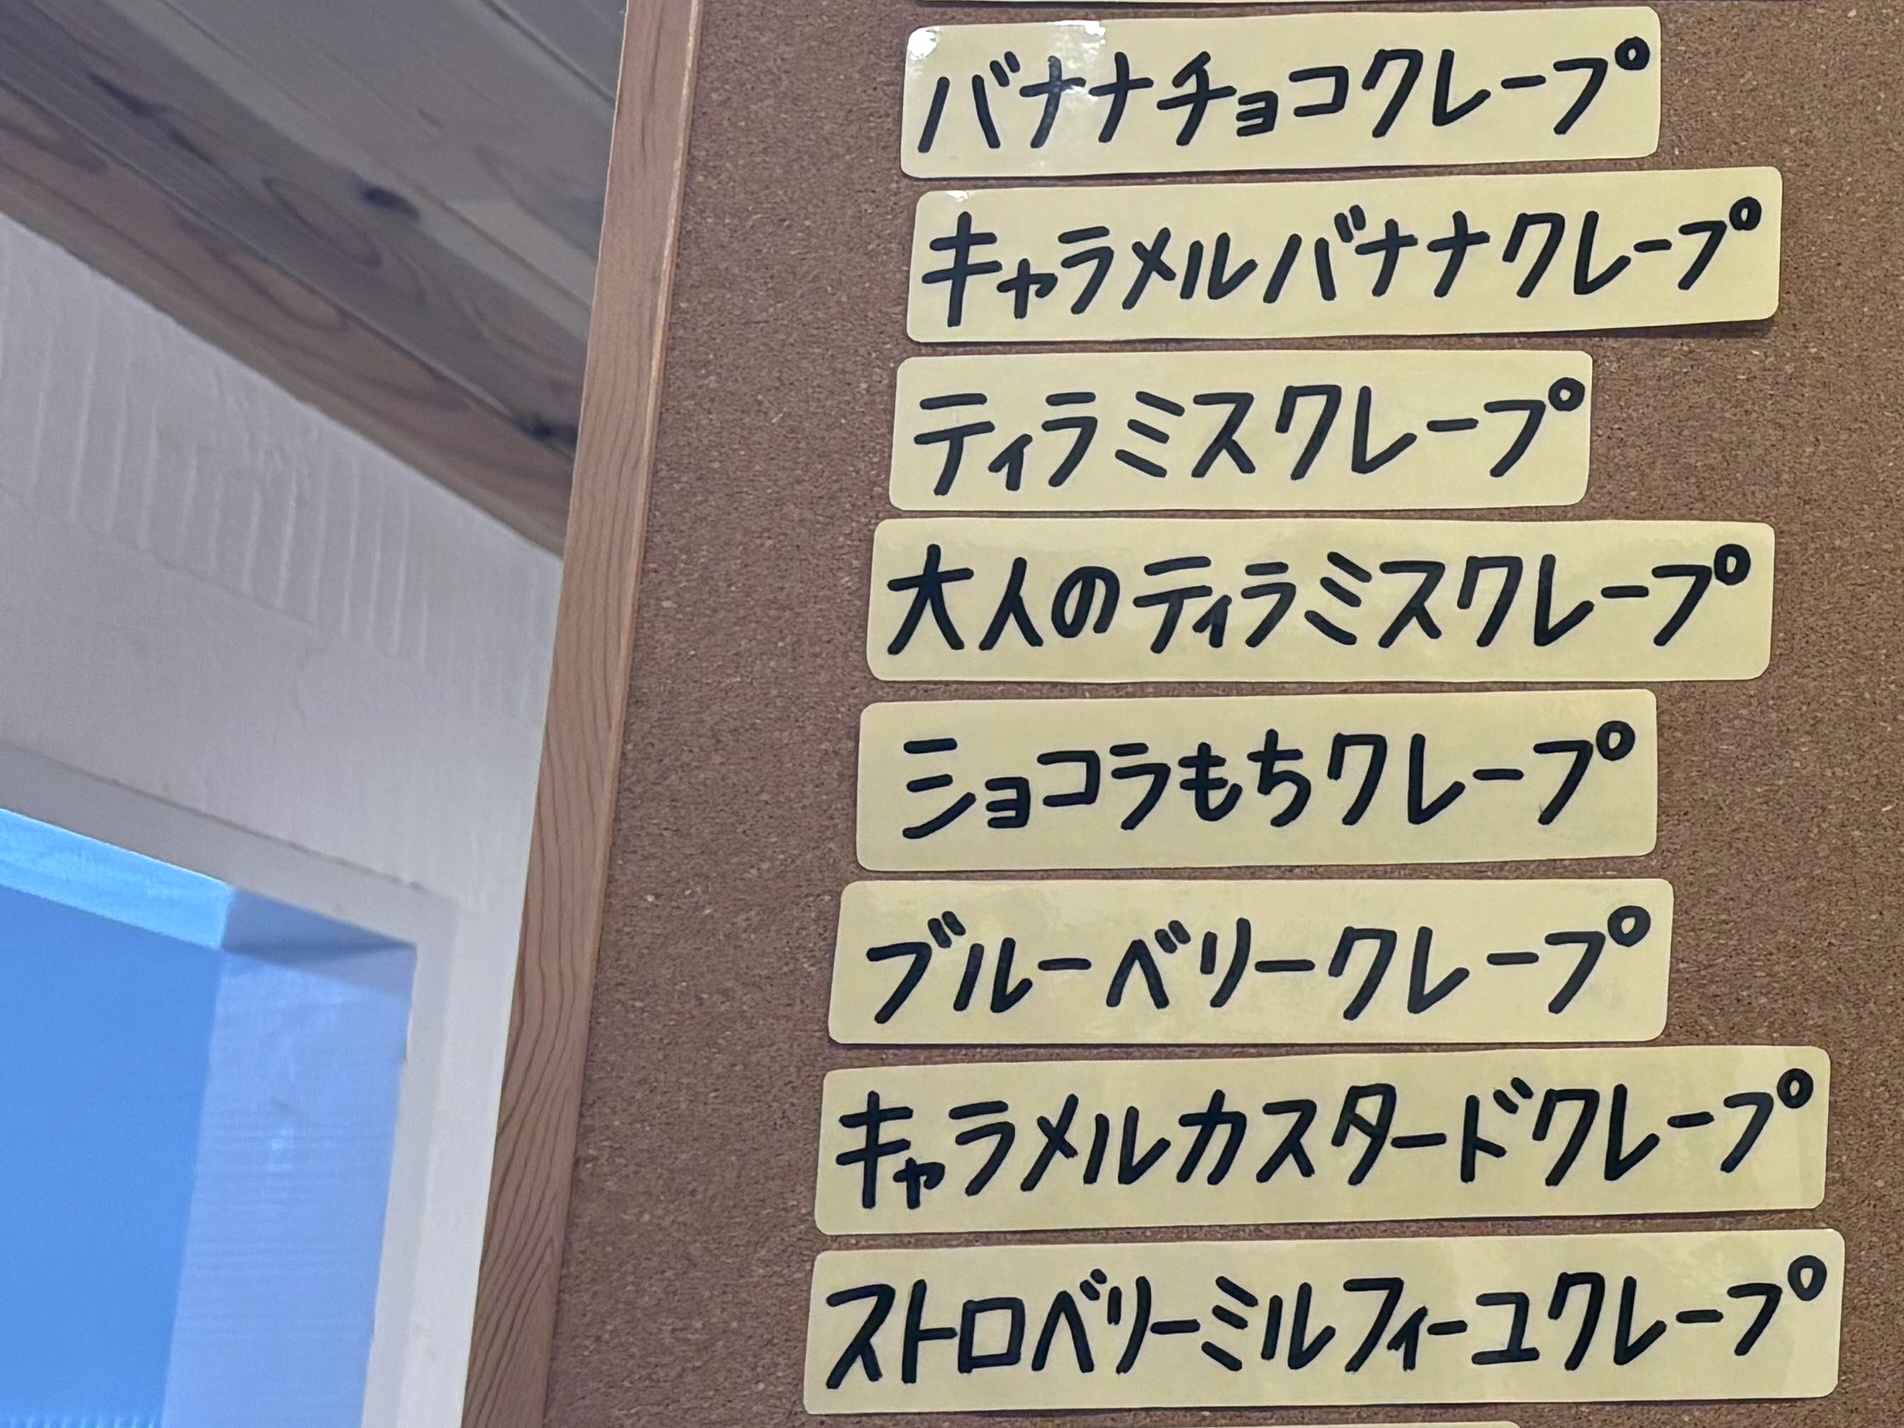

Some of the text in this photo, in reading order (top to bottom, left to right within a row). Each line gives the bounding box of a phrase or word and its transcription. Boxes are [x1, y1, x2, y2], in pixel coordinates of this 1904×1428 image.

[917, 36, 1651, 154] バナナチョコクレープ
[921, 196, 1762, 328] キャラメルバナナクレープ
[913, 377, 1587, 496] ティラミスクレープ
[886, 543, 1752, 656] 大人のティラミスクレープ
[902, 720, 1636, 840] ショコラもちクレープ
[865, 905, 1651, 1025] ブルーベリークレープ
[834, 1067, 1815, 1210] キャラメルカスタードクレープ
[825, 1254, 1828, 1390] ストロベリーミルフィーユクレープ
